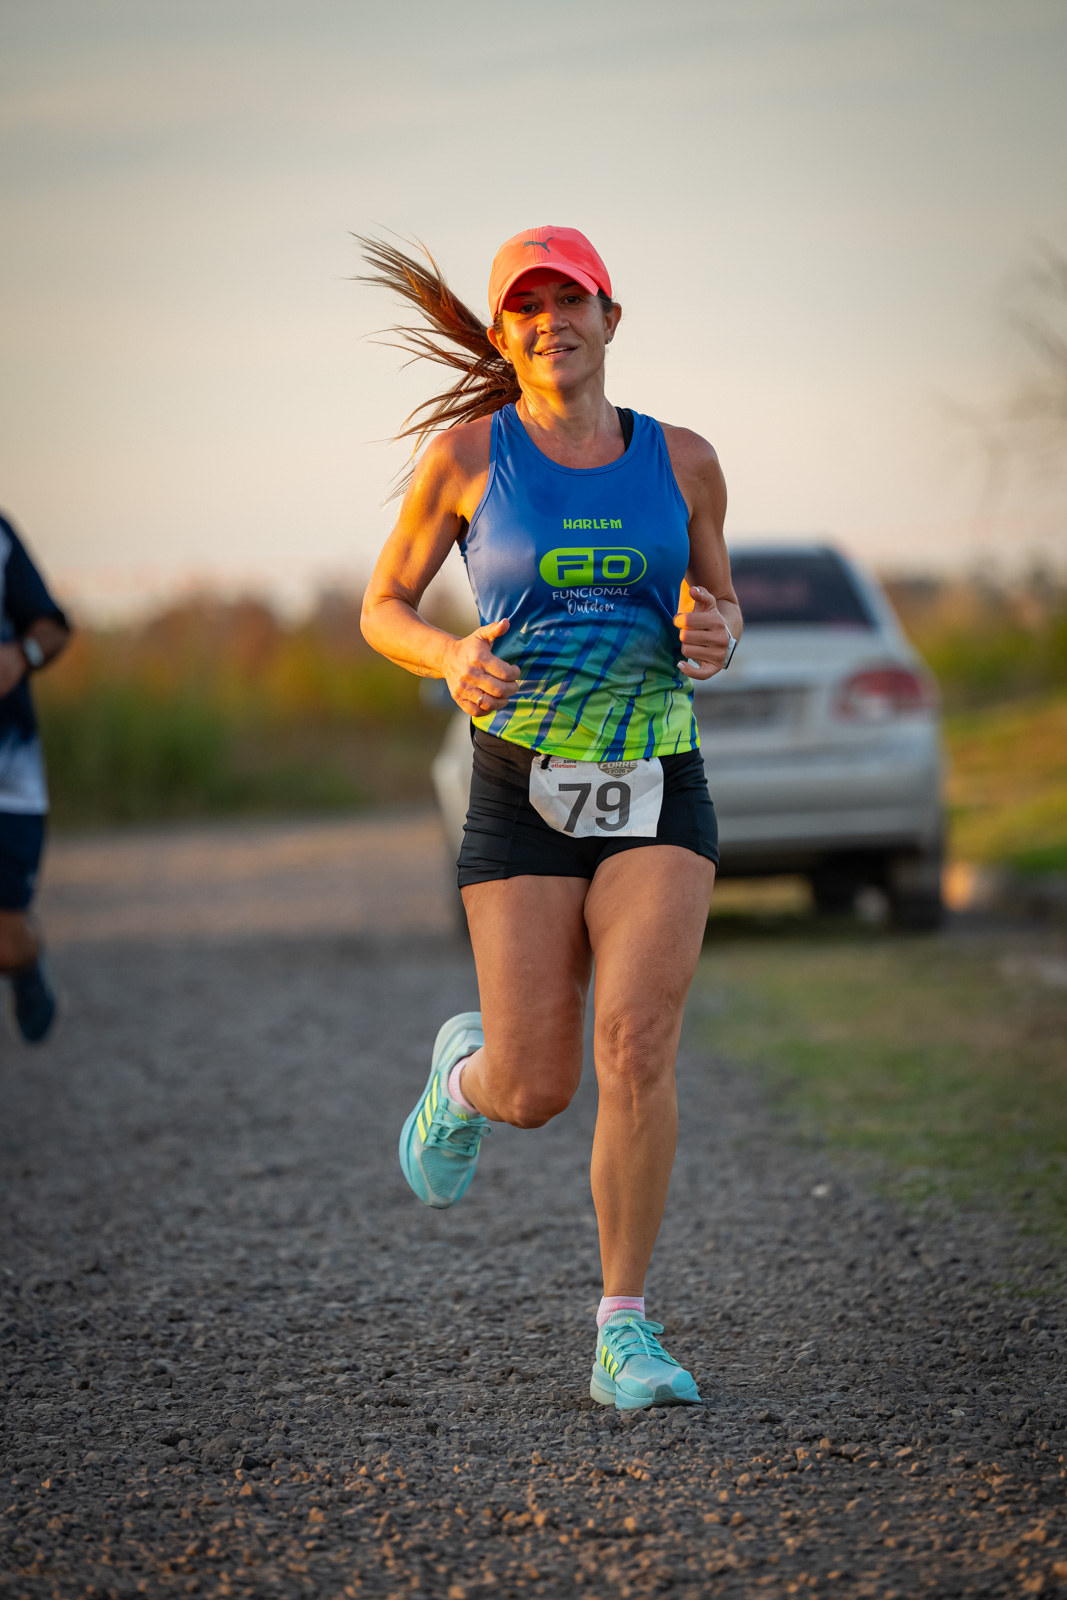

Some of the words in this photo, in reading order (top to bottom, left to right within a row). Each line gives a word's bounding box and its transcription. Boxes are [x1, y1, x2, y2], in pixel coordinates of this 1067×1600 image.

[563, 518, 622, 530] HARLEM
[552, 587, 629, 600] FUNCIONAL
[567, 599, 615, 615] Outdoor
[600, 761, 638, 769] CORRE
[558, 781, 631, 832] 79
